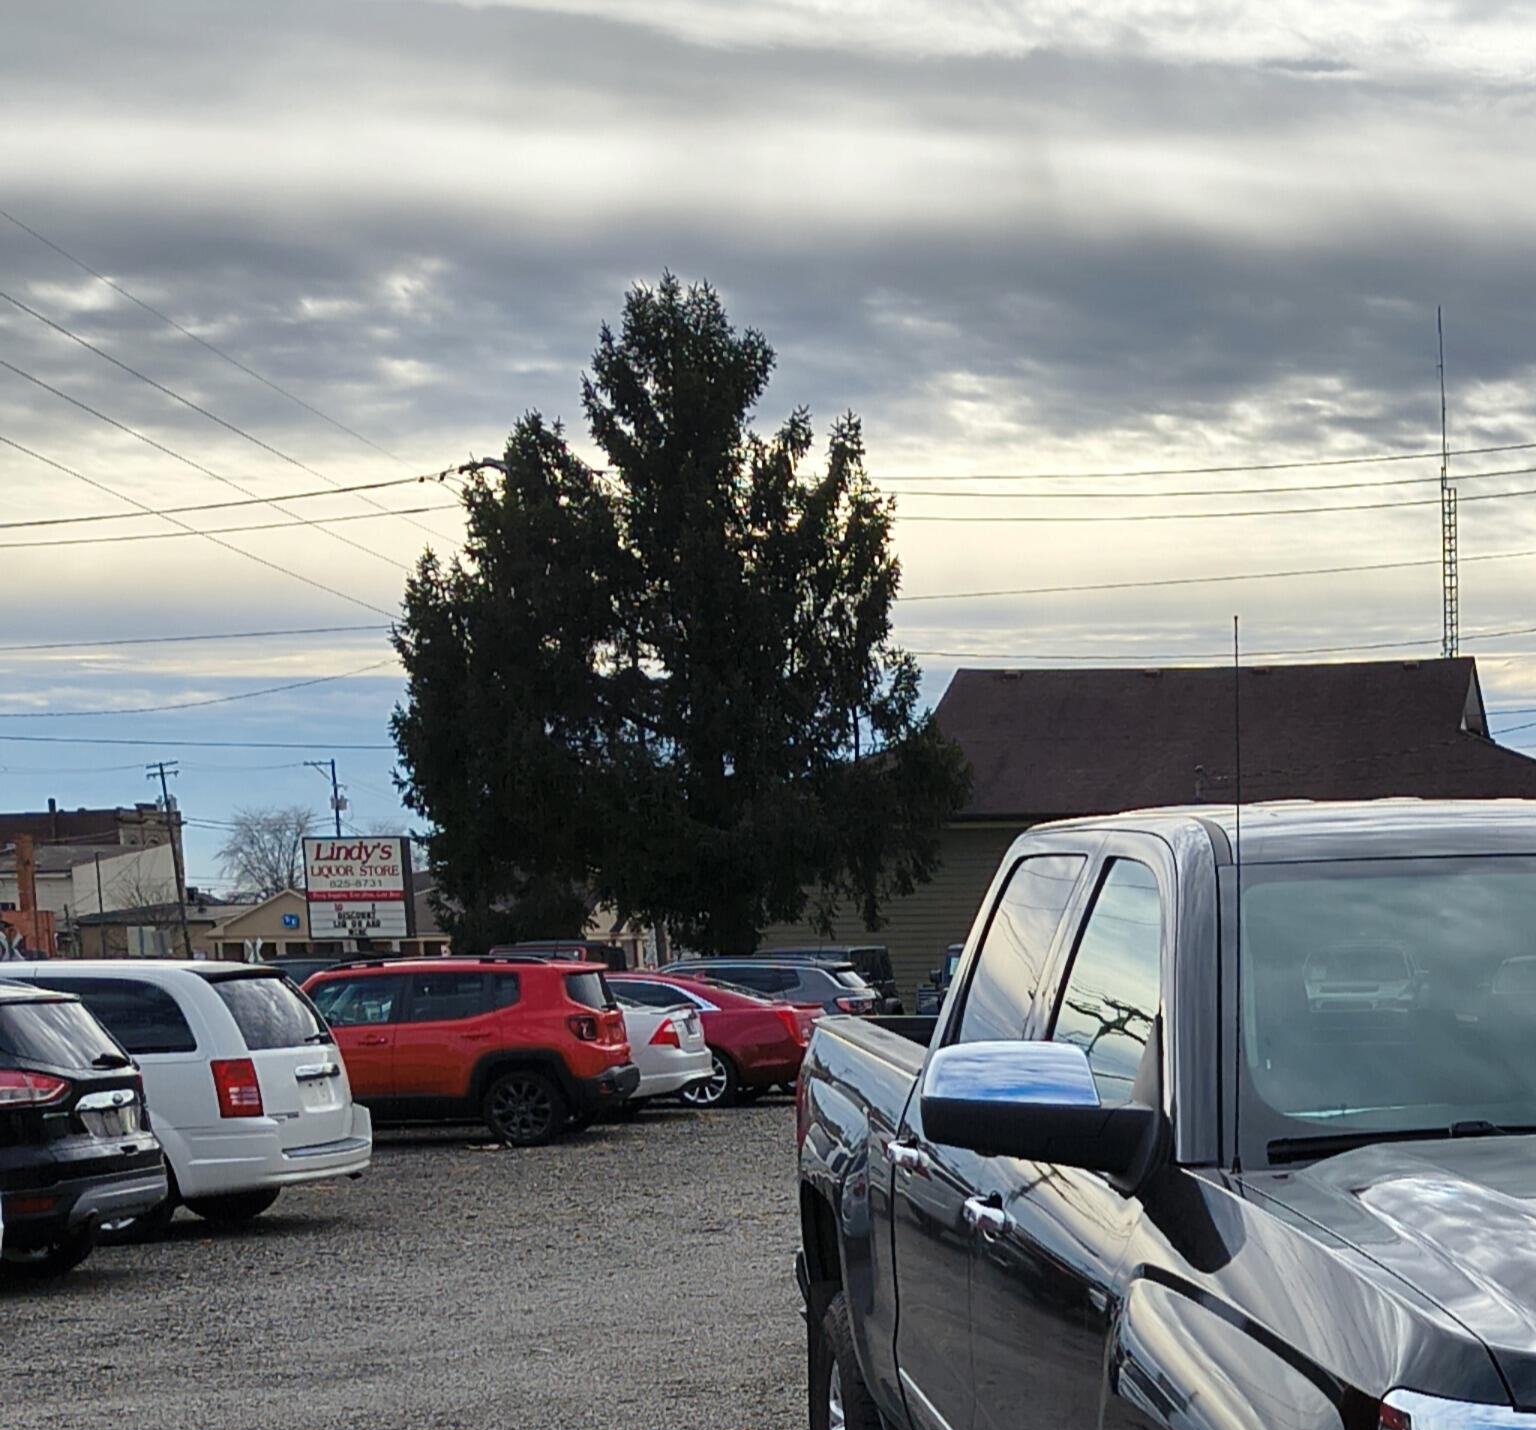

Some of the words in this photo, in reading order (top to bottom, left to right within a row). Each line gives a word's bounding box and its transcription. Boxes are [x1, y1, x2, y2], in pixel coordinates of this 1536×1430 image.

[314, 841, 392, 864] Lindy's
[310, 864, 354, 879] LIQUOR
[359, 864, 400, 877] STORE
